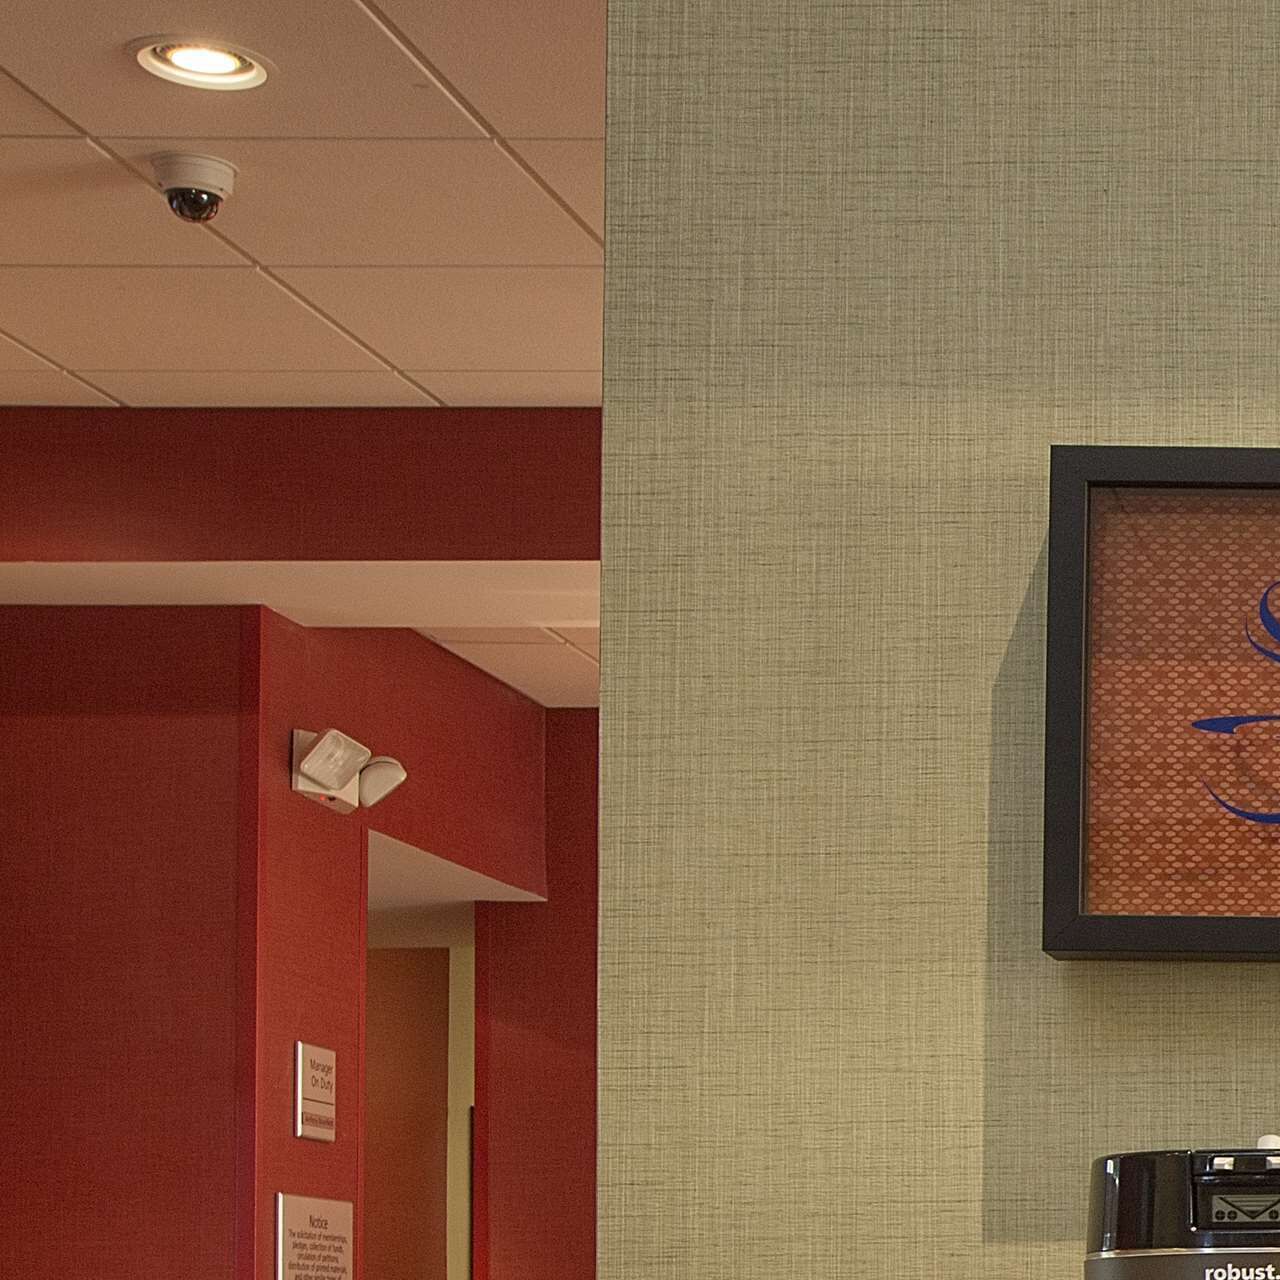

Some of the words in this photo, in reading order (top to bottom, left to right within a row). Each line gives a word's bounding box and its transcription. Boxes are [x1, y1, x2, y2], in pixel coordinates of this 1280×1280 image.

[311, 1075, 319, 1088] On
[309, 1214, 328, 1230] Notice
[1204, 1263, 1280, 1280] robust.
